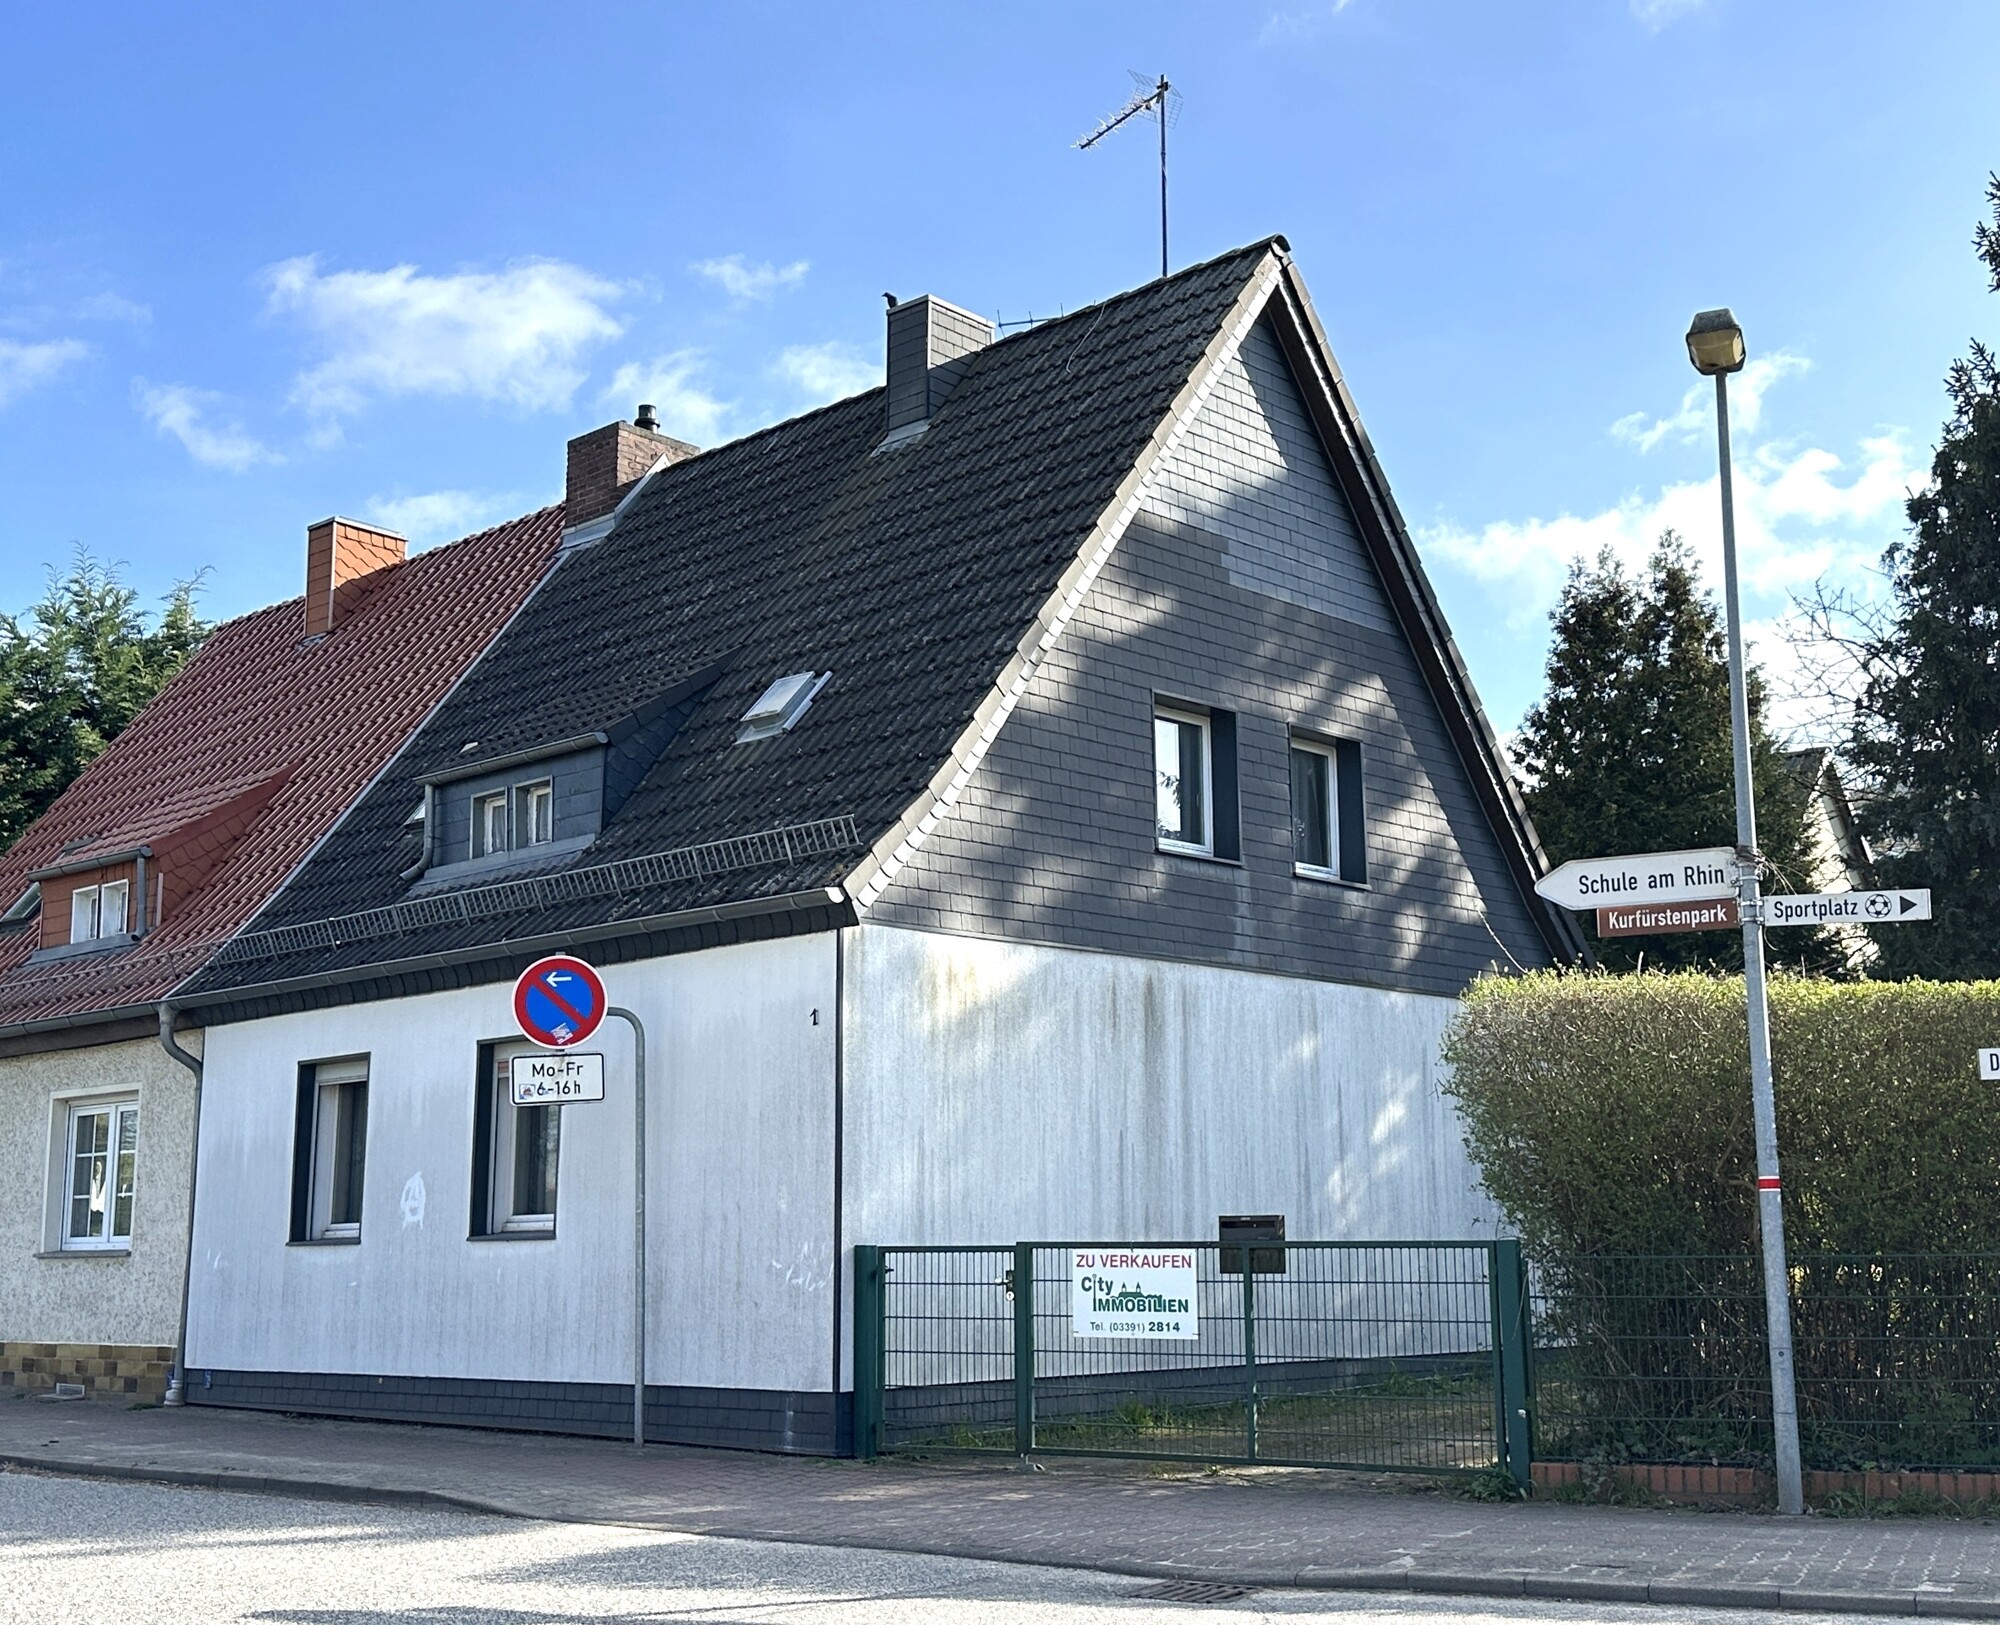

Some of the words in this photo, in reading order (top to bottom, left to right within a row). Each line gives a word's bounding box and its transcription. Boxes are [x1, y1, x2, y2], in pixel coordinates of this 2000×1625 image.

[1579, 872, 1638, 894] Schule
[1648, 873, 1675, 889] am
[1684, 864, 1725, 886] Rhin
[1608, 904, 1728, 929] Kurfürstenpark
[1774, 899, 1859, 922] Sportplatz
[809, 1008, 819, 1026] 1
[532, 1062, 584, 1078] Mo-Fr
[1076, 1254, 1096, 1268] ZU
[1100, 1254, 1192, 1268] VERKAUFEN
[1081, 1274, 1114, 1296] City
[1092, 1298, 1189, 1313] IMMOBILIEN
[1090, 1321, 1106, 1331] Tel.
[1109, 1322, 1145, 1333] (03391)
[1148, 1321, 1180, 1332] 2814
